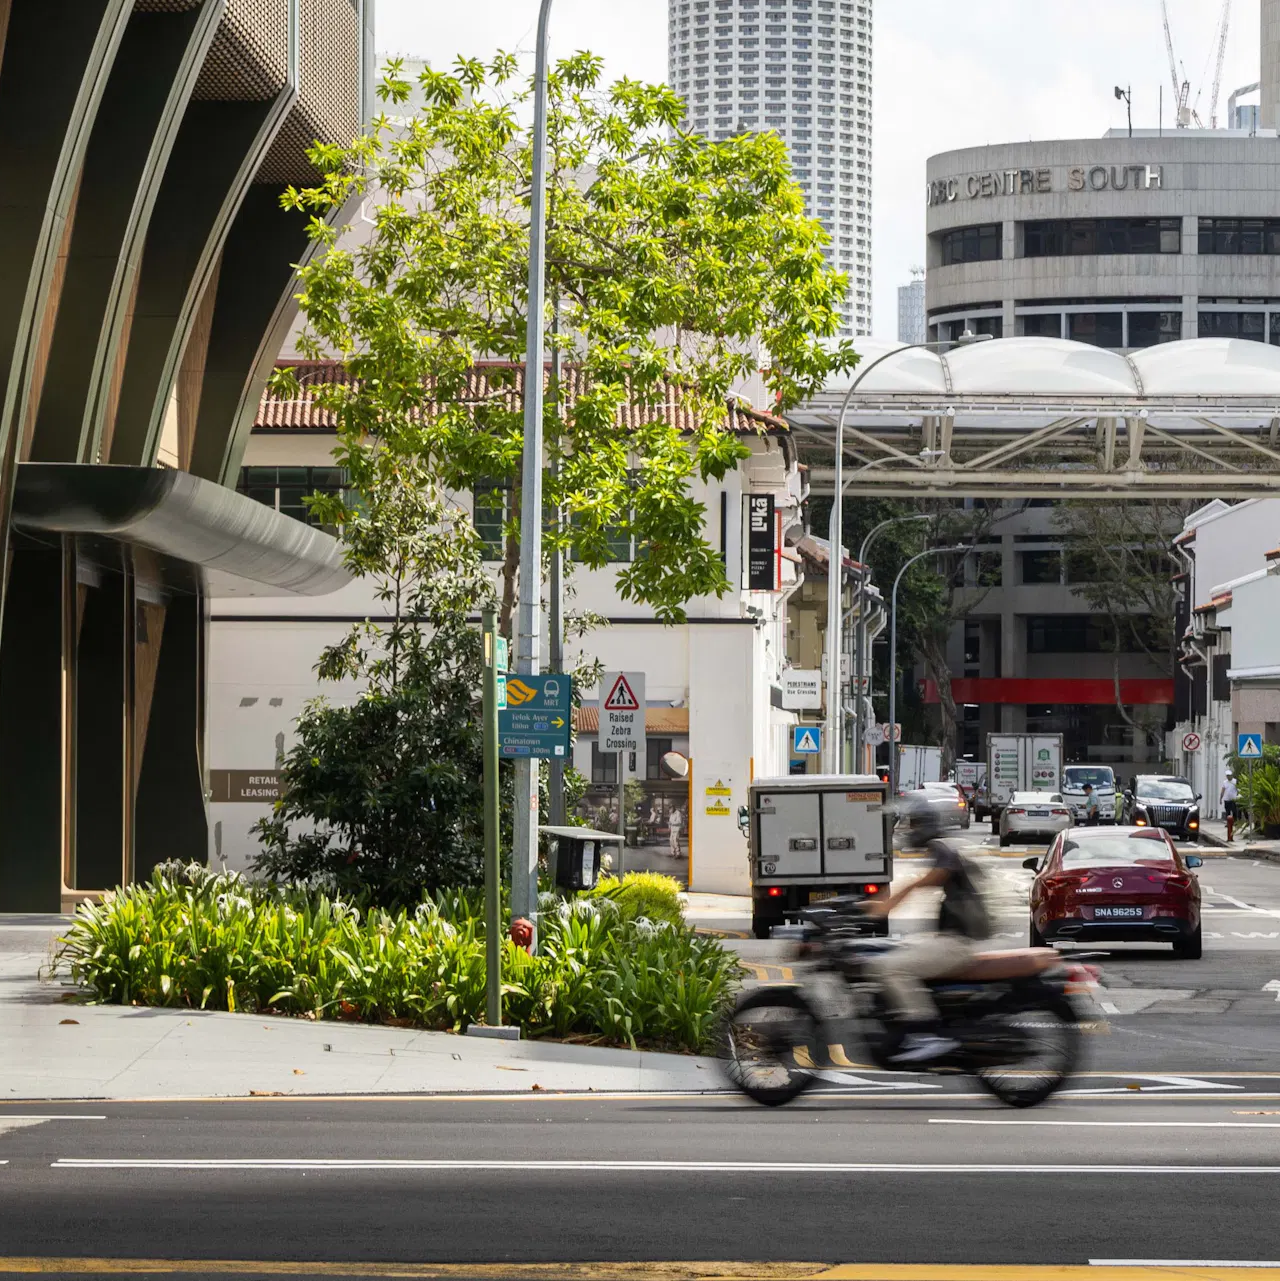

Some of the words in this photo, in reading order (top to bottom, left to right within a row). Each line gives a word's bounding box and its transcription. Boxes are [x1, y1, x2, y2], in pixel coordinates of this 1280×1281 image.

[967, 168, 1051, 199] CENTRE
[1069, 165, 1163, 191] SOUTH
[532, 714, 548, 722] Ayer
[609, 713, 634, 722] Raised
[611, 726, 631, 735] Zebra
[503, 737, 540, 745] Chinatown
[606, 738, 637, 750] Crossing
[248, 776, 279, 784] RETAIL
[241, 788, 279, 797] LEASING
